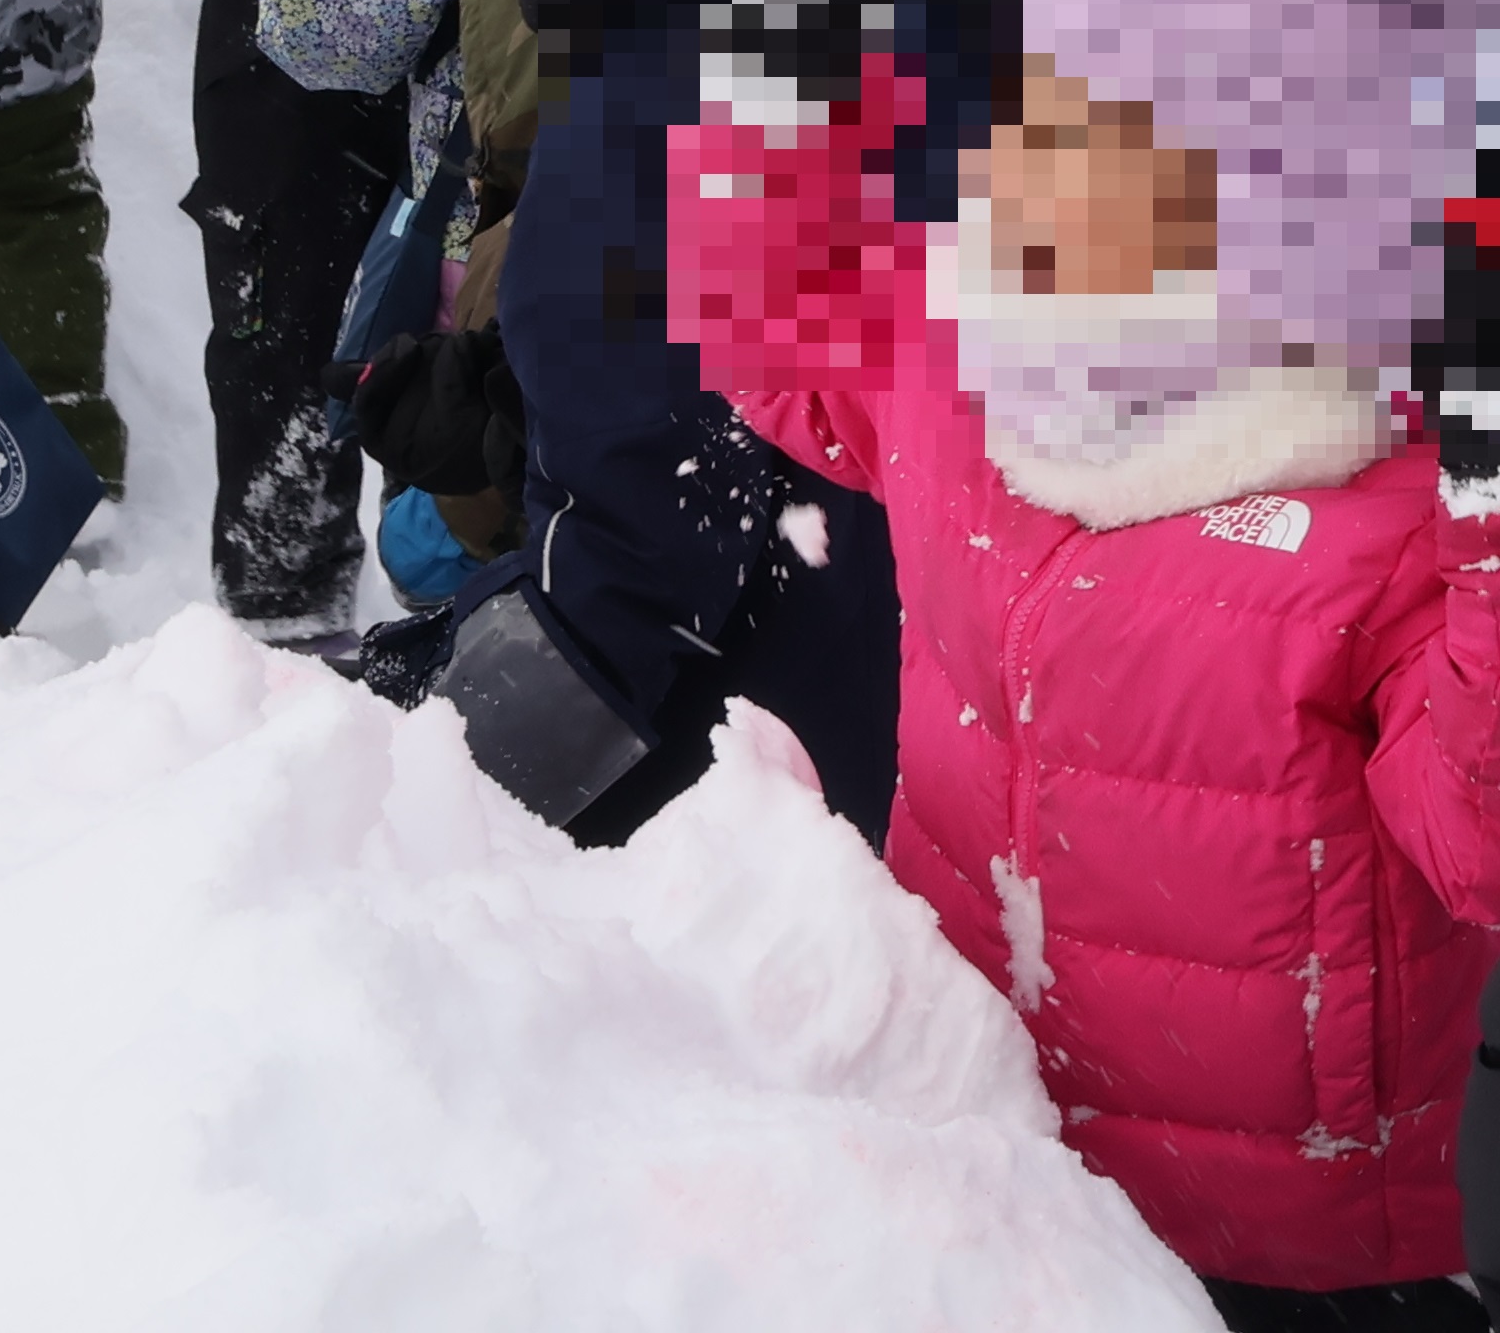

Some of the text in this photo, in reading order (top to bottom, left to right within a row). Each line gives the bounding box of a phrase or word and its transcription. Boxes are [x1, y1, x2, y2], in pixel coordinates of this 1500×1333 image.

[1240, 495, 1287, 513] THE
[1192, 505, 1274, 527] NORTH
[1200, 520, 1261, 545] FACE
